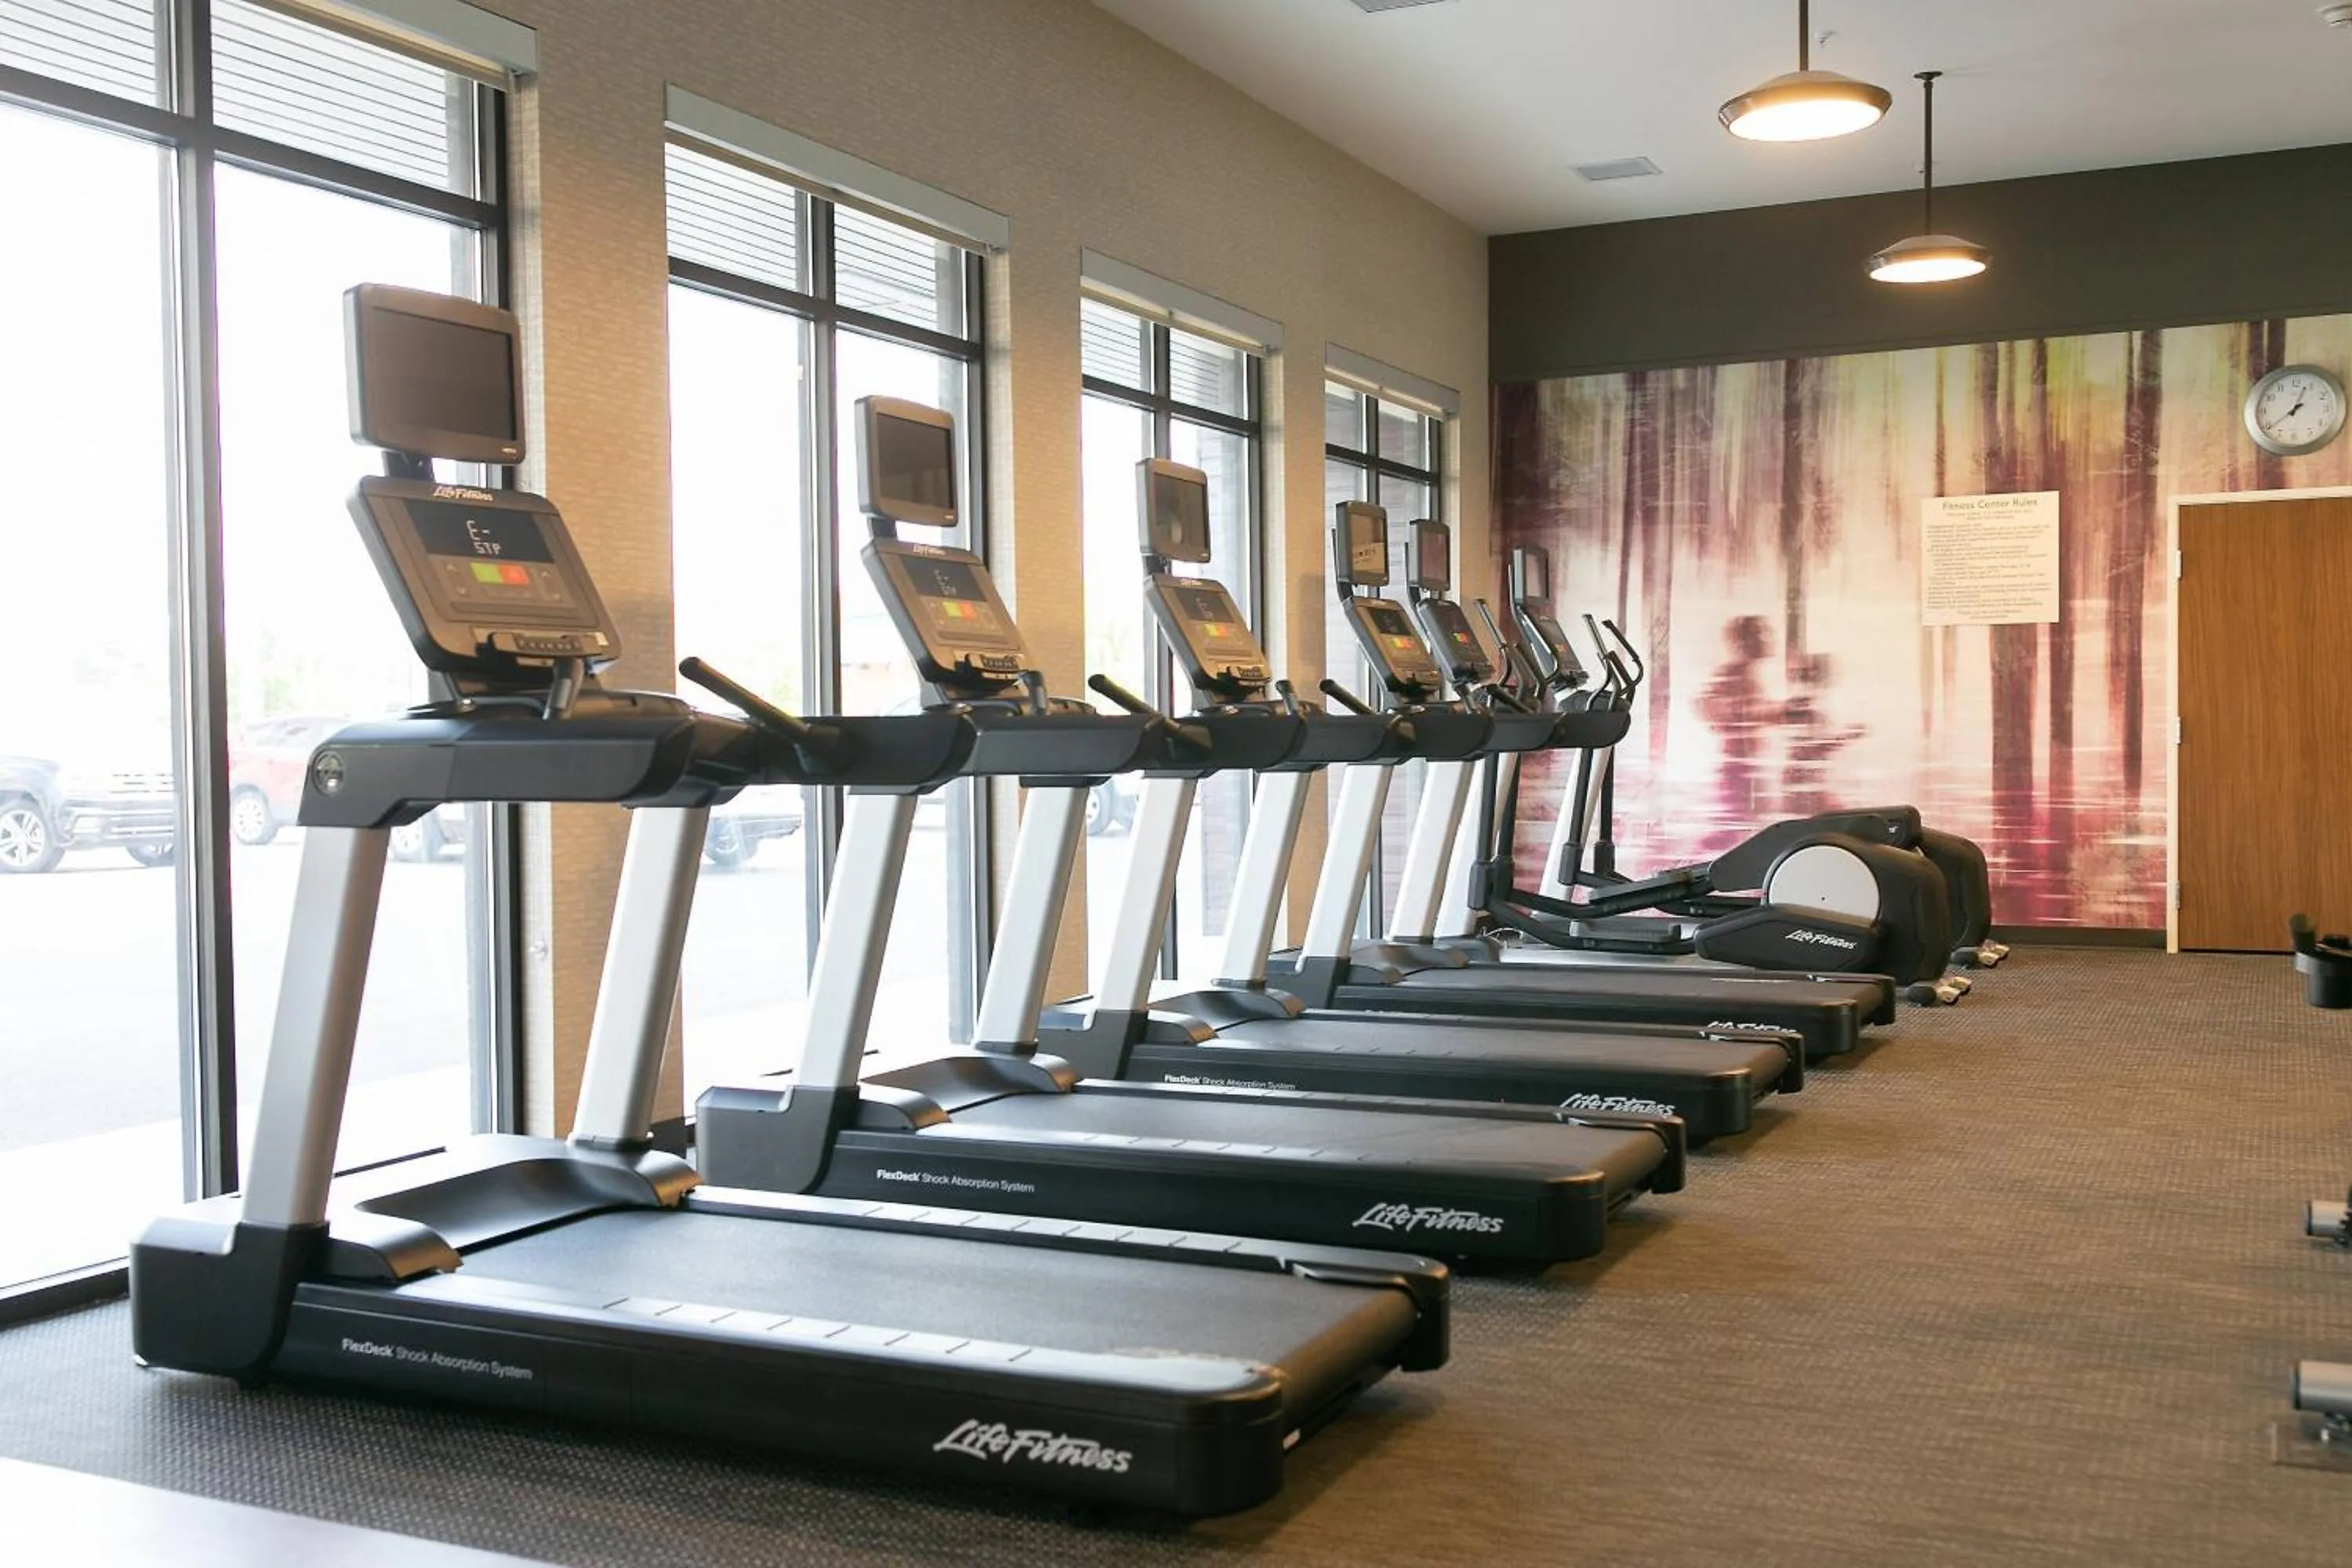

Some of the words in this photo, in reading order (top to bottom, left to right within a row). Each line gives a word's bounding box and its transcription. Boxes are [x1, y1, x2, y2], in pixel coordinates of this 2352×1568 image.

[877, 1169, 920, 1181] FlexDeck
[922, 1173, 949, 1184] Shock
[951, 1175, 1000, 1189] Absorption
[1001, 1179, 1035, 1192] System
[342, 1338, 394, 1357] FlexDeck
[395, 1346, 429, 1361] Shock
[431, 1352, 489, 1372] Absorption
[490, 1360, 533, 1380] System
